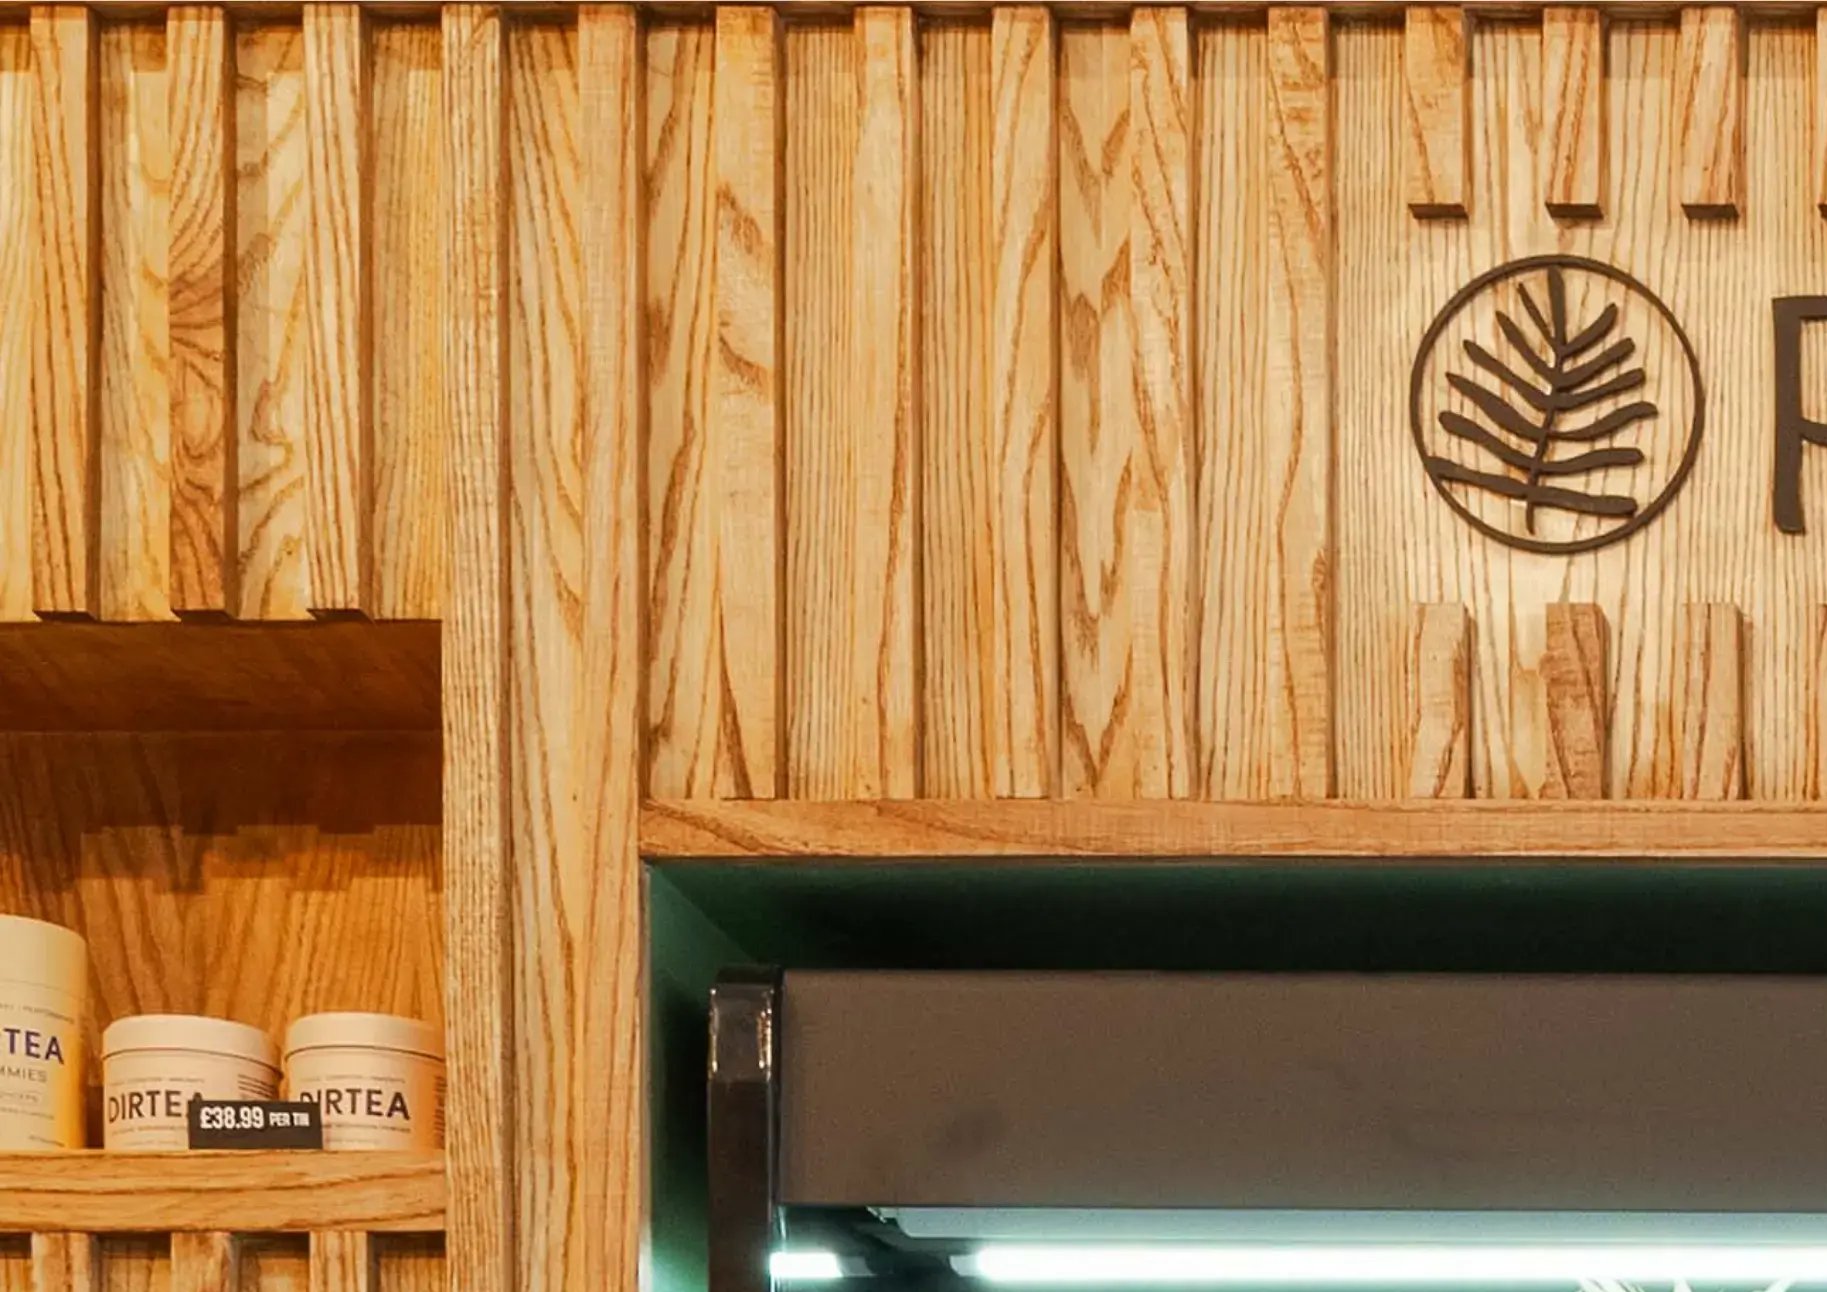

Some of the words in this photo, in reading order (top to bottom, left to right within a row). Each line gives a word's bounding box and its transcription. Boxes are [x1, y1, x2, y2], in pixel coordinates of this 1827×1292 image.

[200, 1107, 264, 1129] £38.99
[270, 1112, 290, 1126] PER
[293, 1112, 309, 1126] TIN
